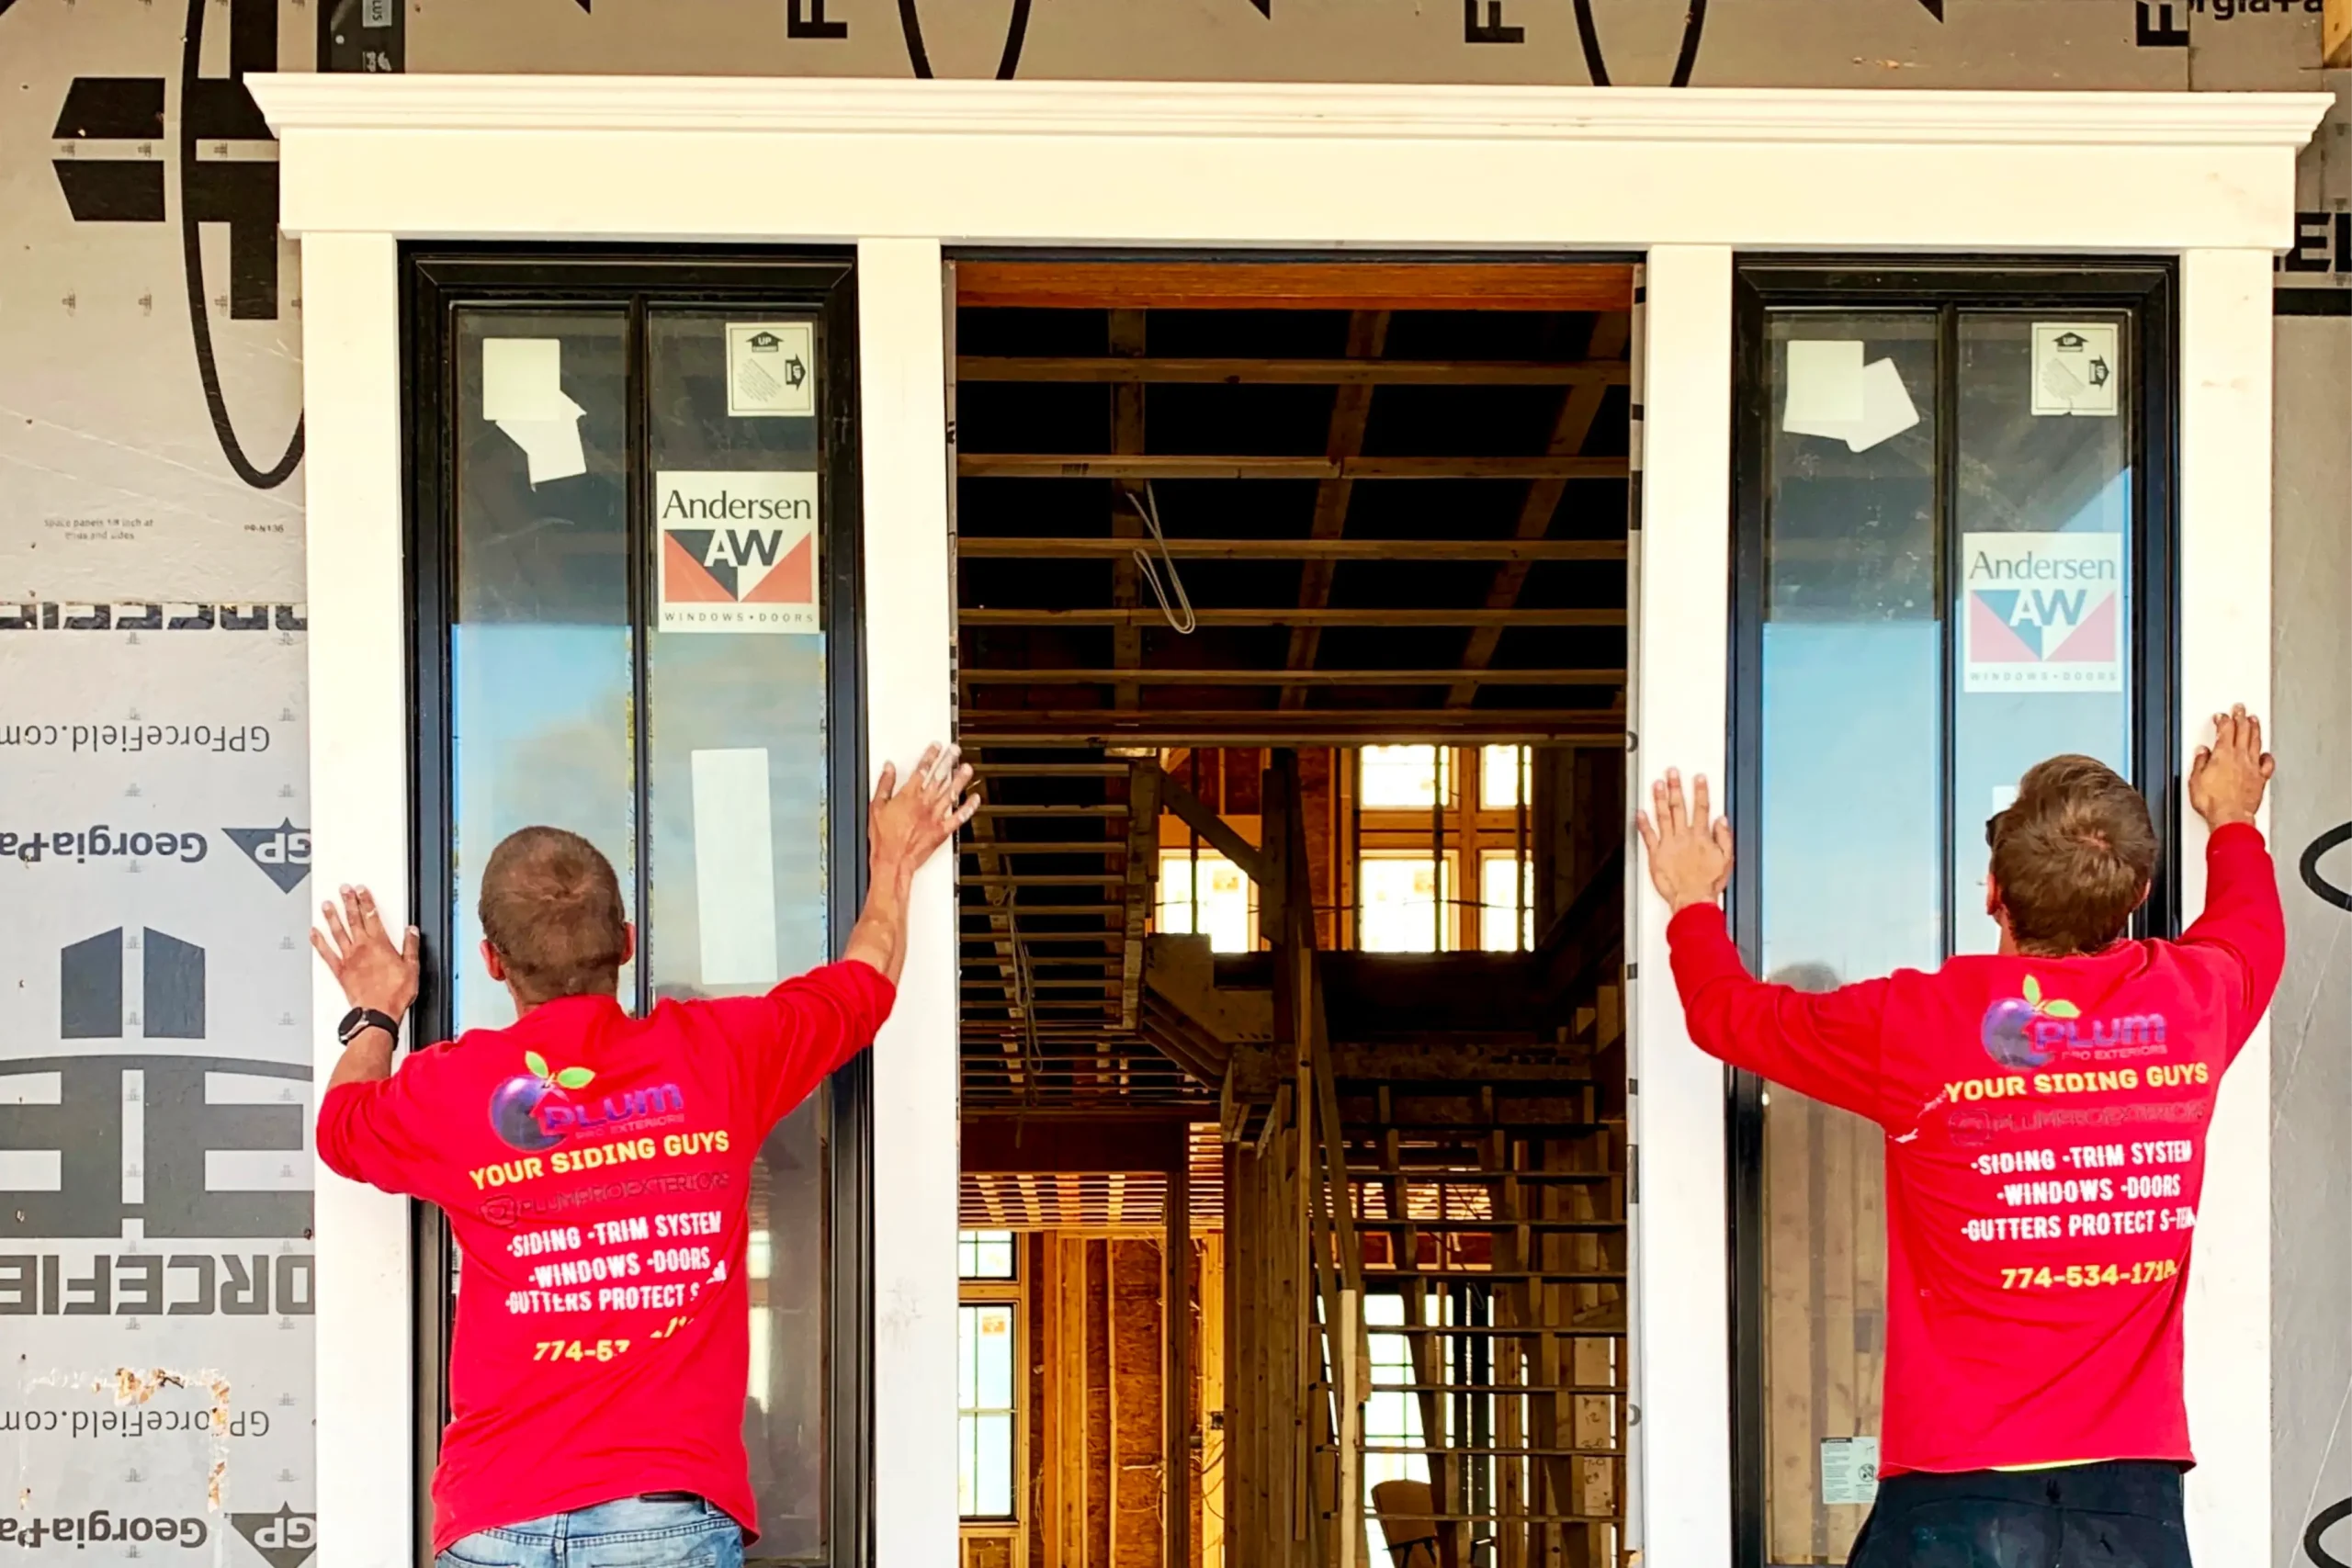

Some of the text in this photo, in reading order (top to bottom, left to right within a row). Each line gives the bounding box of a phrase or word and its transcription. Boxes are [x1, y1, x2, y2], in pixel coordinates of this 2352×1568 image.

[758, 336, 772, 345] UP
[662, 490, 811, 520] Andersen
[704, 529, 783, 567] AW
[1969, 551, 2117, 580] Andersen
[664, 613, 813, 624] WINDOWS DOORS
[2009, 589, 2087, 626] AW
[0, 725, 271, 752] GPForceField.com
[254, 837, 311, 865] GP
[1945, 1062, 2209, 1103] YOUR SIDING GUYS
[469, 1130, 729, 1190] YOUR SIDING GUYS
[2068, 1210, 2156, 1237] PROTECT
[0, 1255, 314, 1315] ORCEFIE
[599, 1282, 685, 1311] PROTECT
[0, 1410, 270, 1438] GPorceField.com
[254, 1516, 316, 1550] GP
